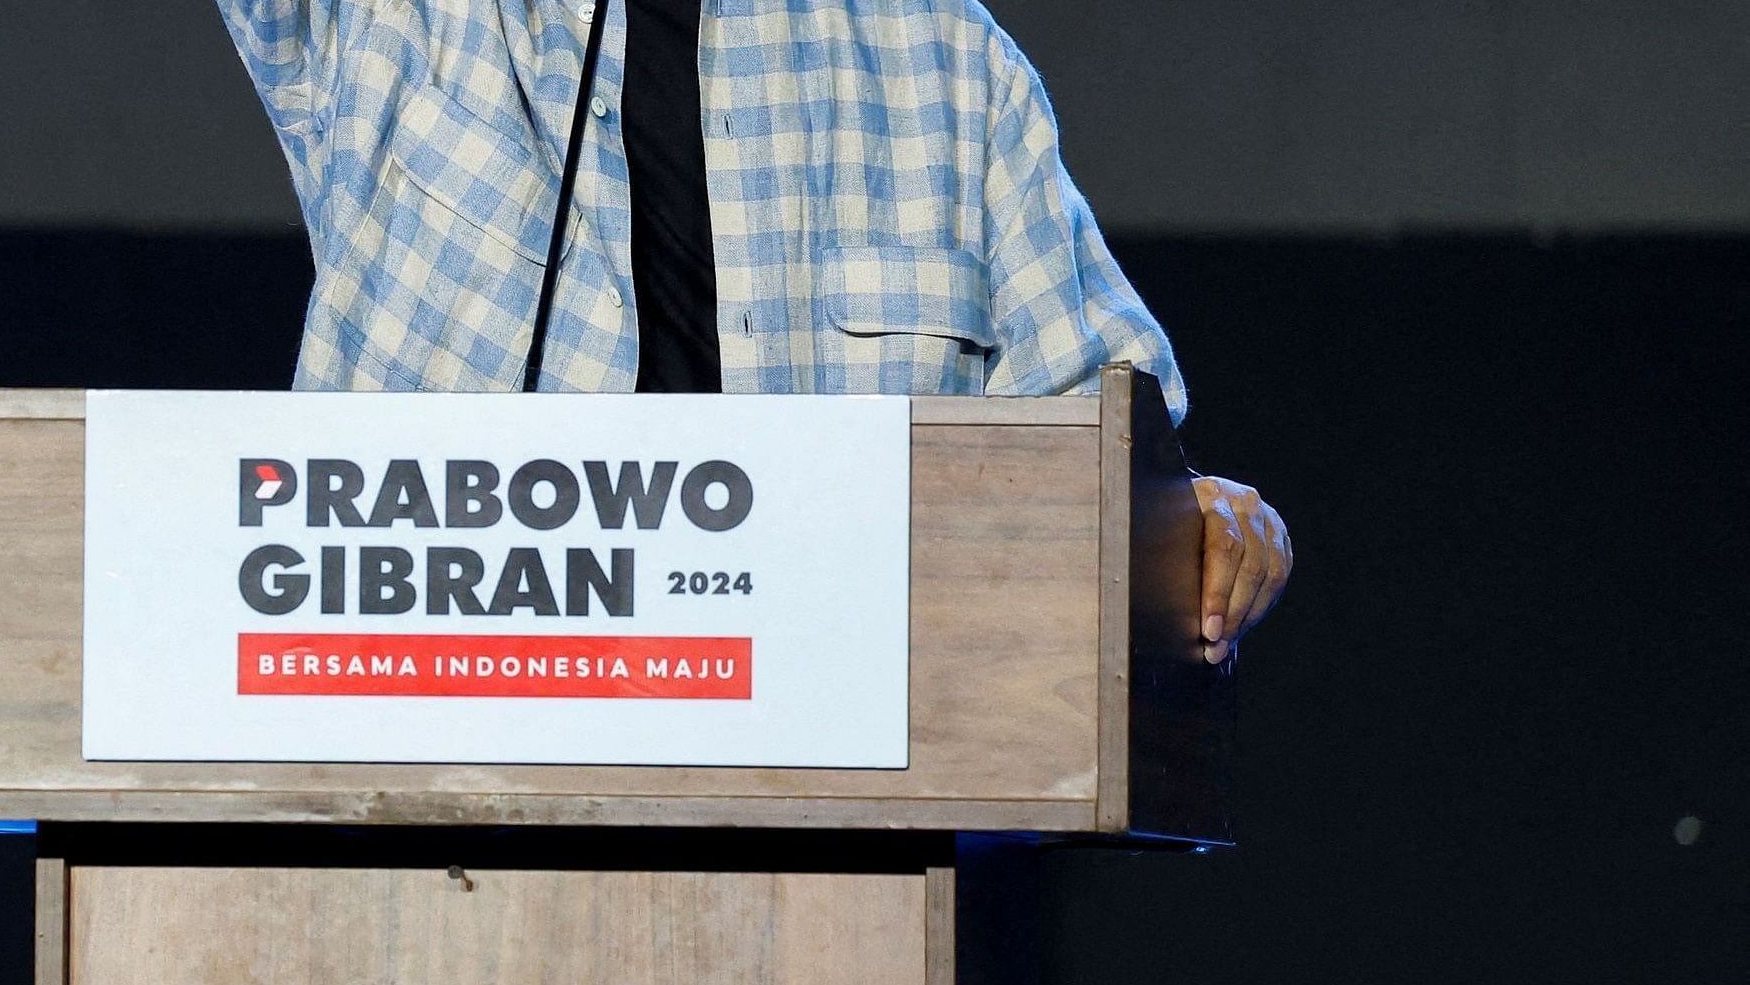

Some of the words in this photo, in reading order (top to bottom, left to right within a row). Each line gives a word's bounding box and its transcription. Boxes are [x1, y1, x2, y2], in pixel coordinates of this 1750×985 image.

[238, 458, 755, 532] PRABOWO
[238, 544, 636, 617] GIBRAN
[667, 570, 754, 596] 2024
[257, 653, 419, 677] BERSAMA
[434, 654, 630, 680] INDONESIA
[645, 657, 735, 681] MAJU
